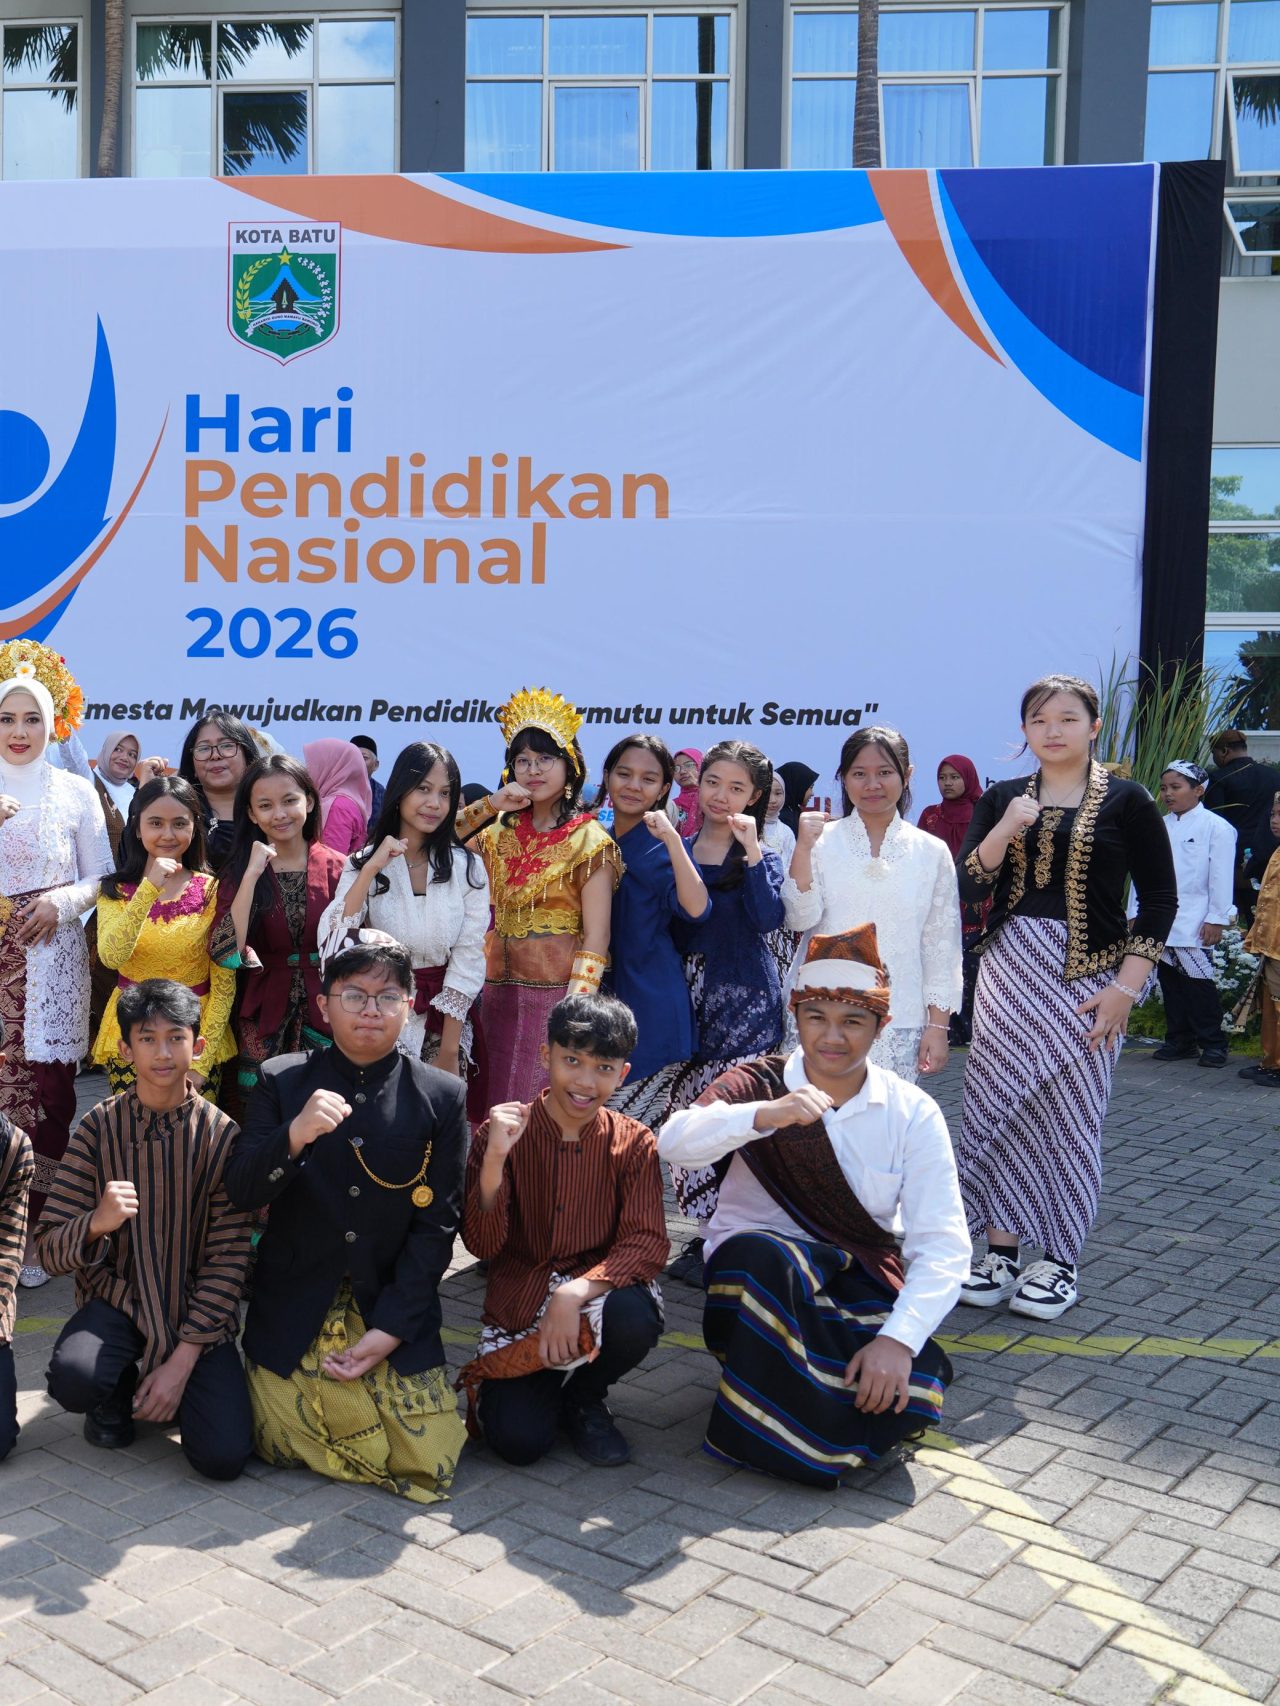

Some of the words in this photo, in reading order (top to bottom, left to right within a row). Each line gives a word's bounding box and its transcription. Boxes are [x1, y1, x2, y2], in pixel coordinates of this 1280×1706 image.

[236, 229, 283, 243] KOTA
[289, 229, 336, 243] BATU
[185, 387, 354, 453] Hari
[185, 453, 670, 519] Pendidikan
[184, 518, 547, 584] Nasional
[185, 607, 359, 659] 2026
[84, 699, 174, 721] mesta
[668, 702, 755, 725] untuk
[759, 702, 879, 726] Semua"
